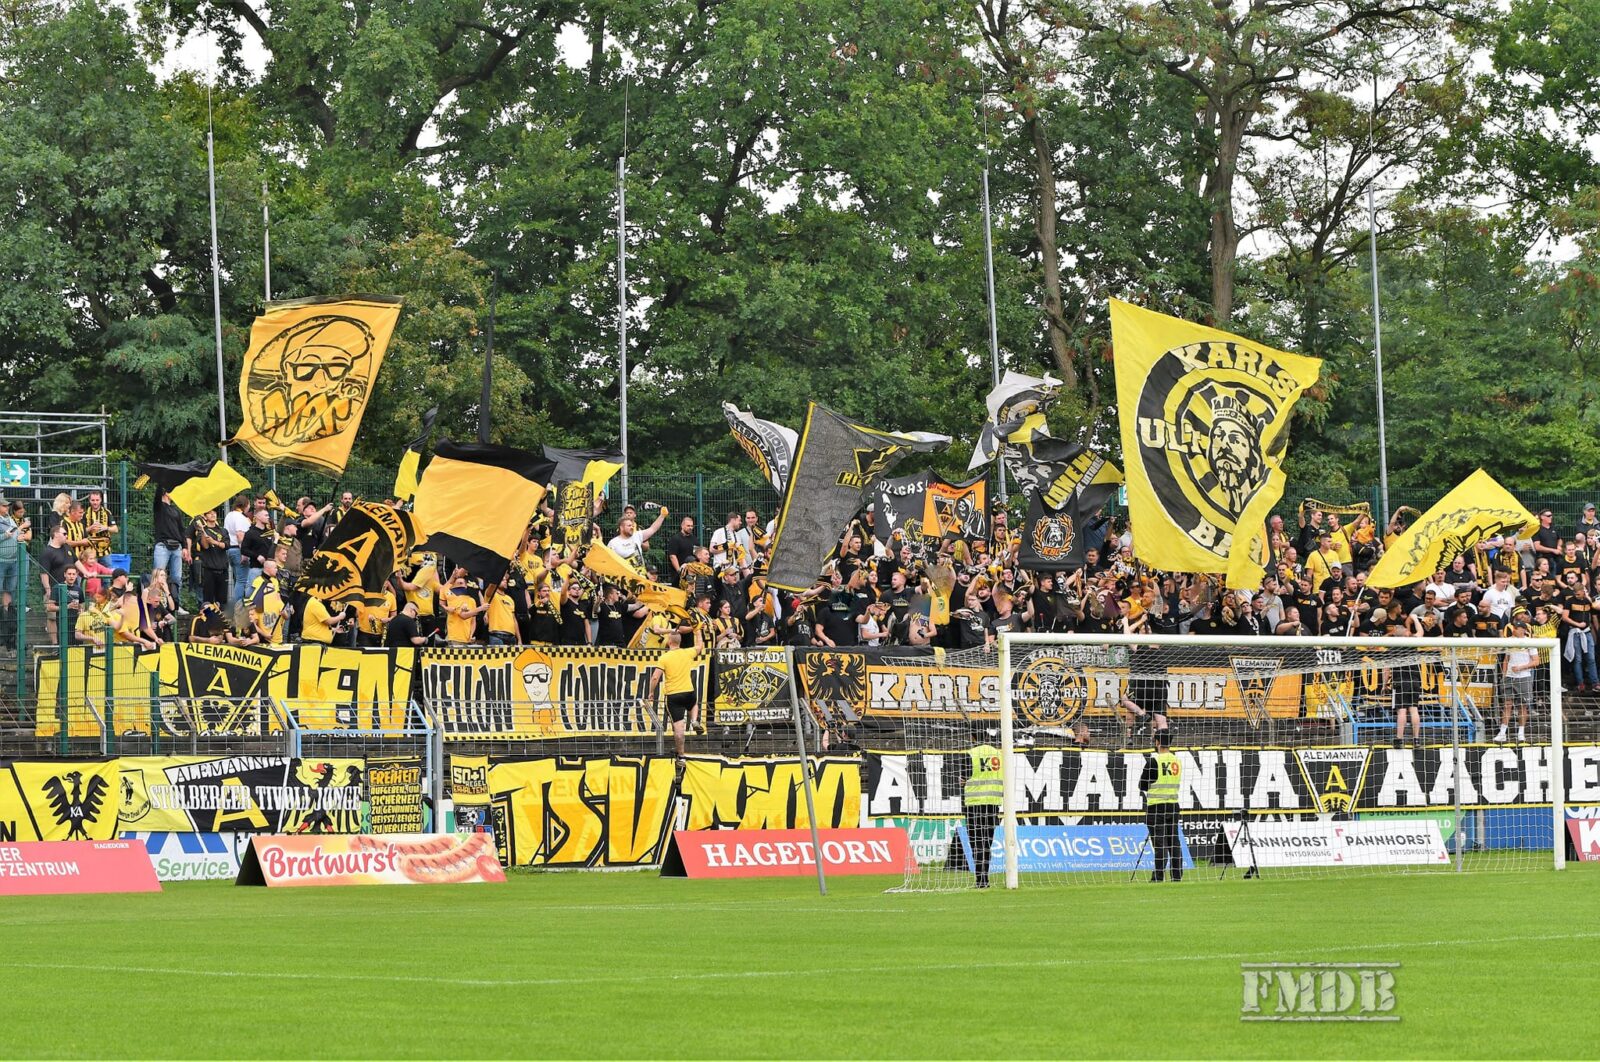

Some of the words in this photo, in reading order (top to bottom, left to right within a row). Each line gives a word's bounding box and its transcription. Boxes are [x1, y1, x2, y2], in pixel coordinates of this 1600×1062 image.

[1170, 342, 1300, 399] KARLS
[186, 643, 263, 668] ALEMANNIA
[1236, 658, 1278, 668] ALEMANNIA
[206, 667, 232, 695] A
[423, 663, 514, 732] YELLOW
[870, 673, 1001, 712] KARLS
[1064, 686, 1088, 698] RAS
[720, 710, 745, 722] UND
[747, 708, 790, 721] VEREIN
[1303, 751, 1364, 761] ALEMANNIA
[176, 756, 288, 784] ALEMANNIA
[979, 757, 1001, 773] K9
[1161, 761, 1180, 777] K9
[370, 769, 419, 785] FREIHEIT
[465, 780, 487, 788] REGEL
[149, 785, 252, 811] STOLBERGER
[255, 785, 311, 811] TIVOLI
[314, 786, 362, 812] JONGE
[371, 794, 420, 805] SICHERHEIT
[371, 806, 381, 815] ZU
[398, 813, 420, 822] BEIDES
[489, 757, 677, 867] TSV
[373, 824, 383, 834] ZU
[384, 822, 421, 833] VERLIEREN
[1240, 836, 1329, 848] PANNHORST
[1346, 833, 1432, 846] PANNHORST
[701, 840, 893, 868] HAGEDORN
[1389, 848, 1436, 856] ENTSORGUNG
[263, 844, 398, 878] Bratwurst
[1068, 861, 1132, 869] Telekommunikation
